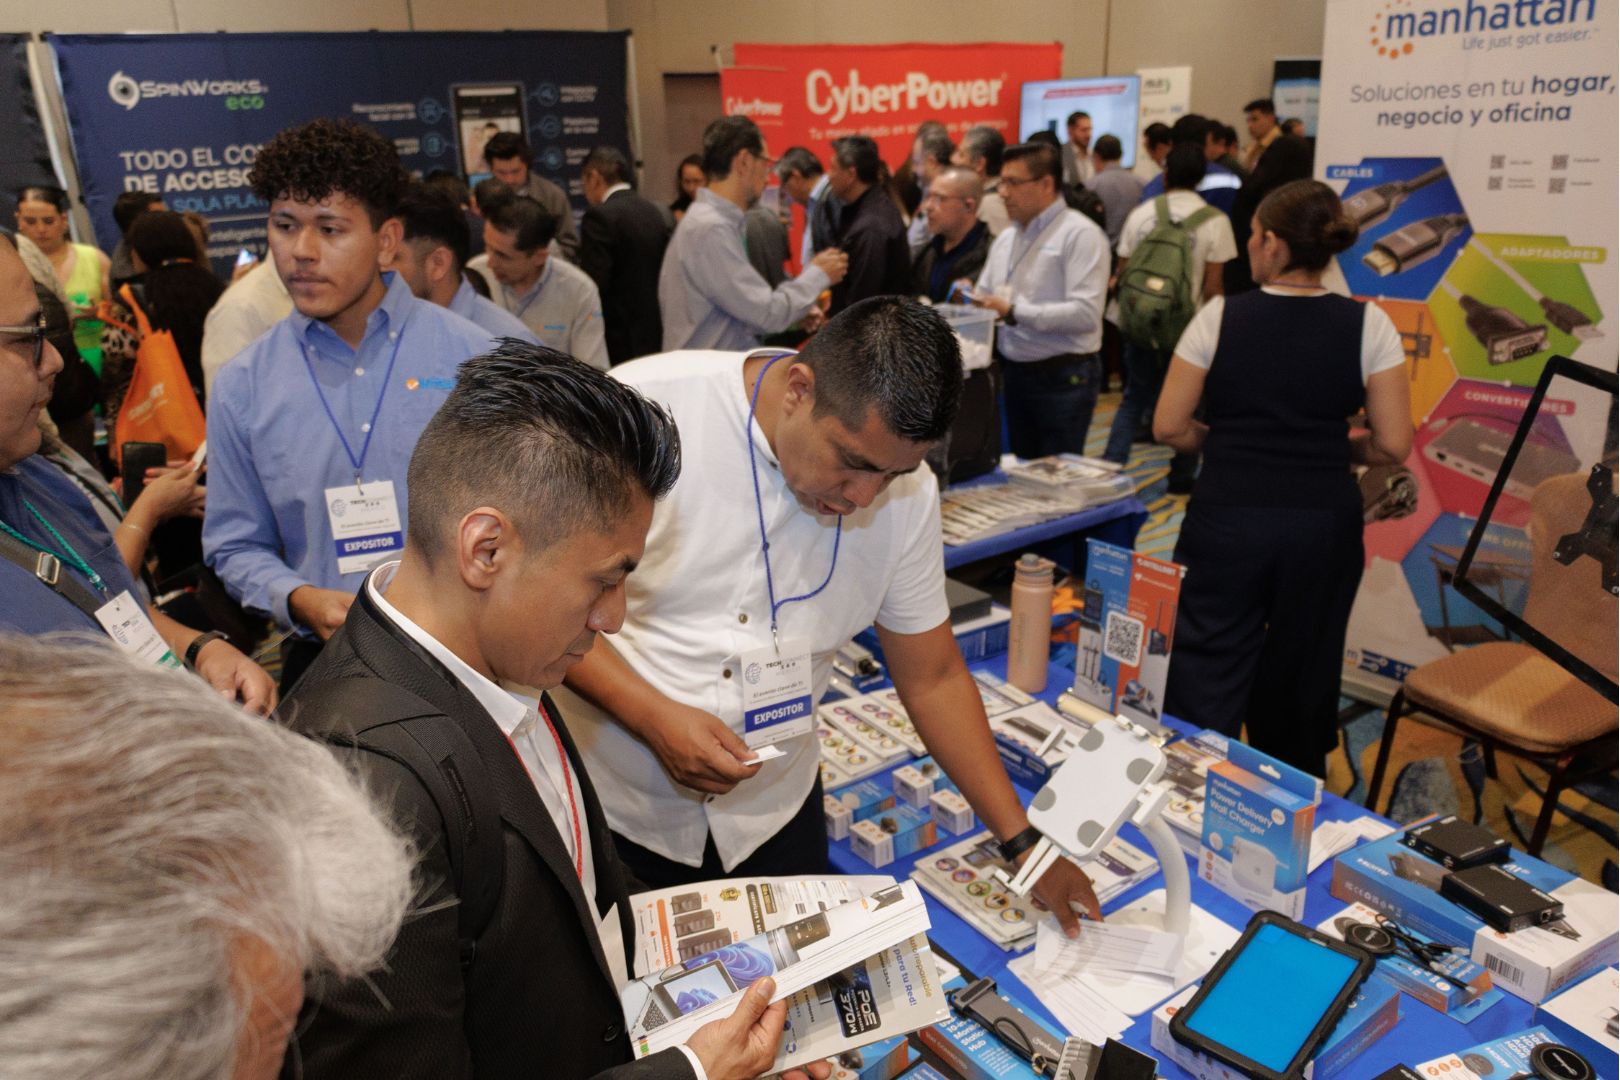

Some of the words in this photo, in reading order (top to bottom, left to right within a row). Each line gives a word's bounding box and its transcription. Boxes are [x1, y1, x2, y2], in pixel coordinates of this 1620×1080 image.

[1386, 0, 1597, 39] manhattan
[1487, 36, 1513, 51] just
[1516, 32, 1541, 49] got
[805, 69, 1003, 124] CyberPower
[1350, 84, 1461, 102] Soluciones
[1467, 84, 1496, 98] en
[1502, 79, 1524, 96] tu
[1531, 74, 1616, 97] hogar,
[225, 96, 265, 110] eco
[1377, 111, 1463, 129] negocio
[1470, 110, 1483, 127] y
[1489, 101, 1572, 123] oficina
[120, 148, 188, 171] TODO
[192, 147, 221, 167] EL
[224, 144, 263, 165] CO
[124, 174, 160, 193] DE
[1333, 168, 1374, 178] CABLES
[1501, 247, 1600, 260] ADAPTADORES
[1464, 391, 1568, 413] CONVERTIRES
[344, 537, 395, 553] EXPOSITOR
[753, 702, 805, 725] EXPOSITOR
[1209, 787, 1236, 808] Power
[1238, 801, 1274, 828] Delivery
[1209, 799, 1230, 816] Wall
[1229, 810, 1266, 836] Charger
[893, 948, 906, 971] para
[902, 972, 910, 983] tu
[905, 985, 917, 1006] Red!
[839, 992, 859, 1034] 370W
[857, 988, 877, 1027] PoE
